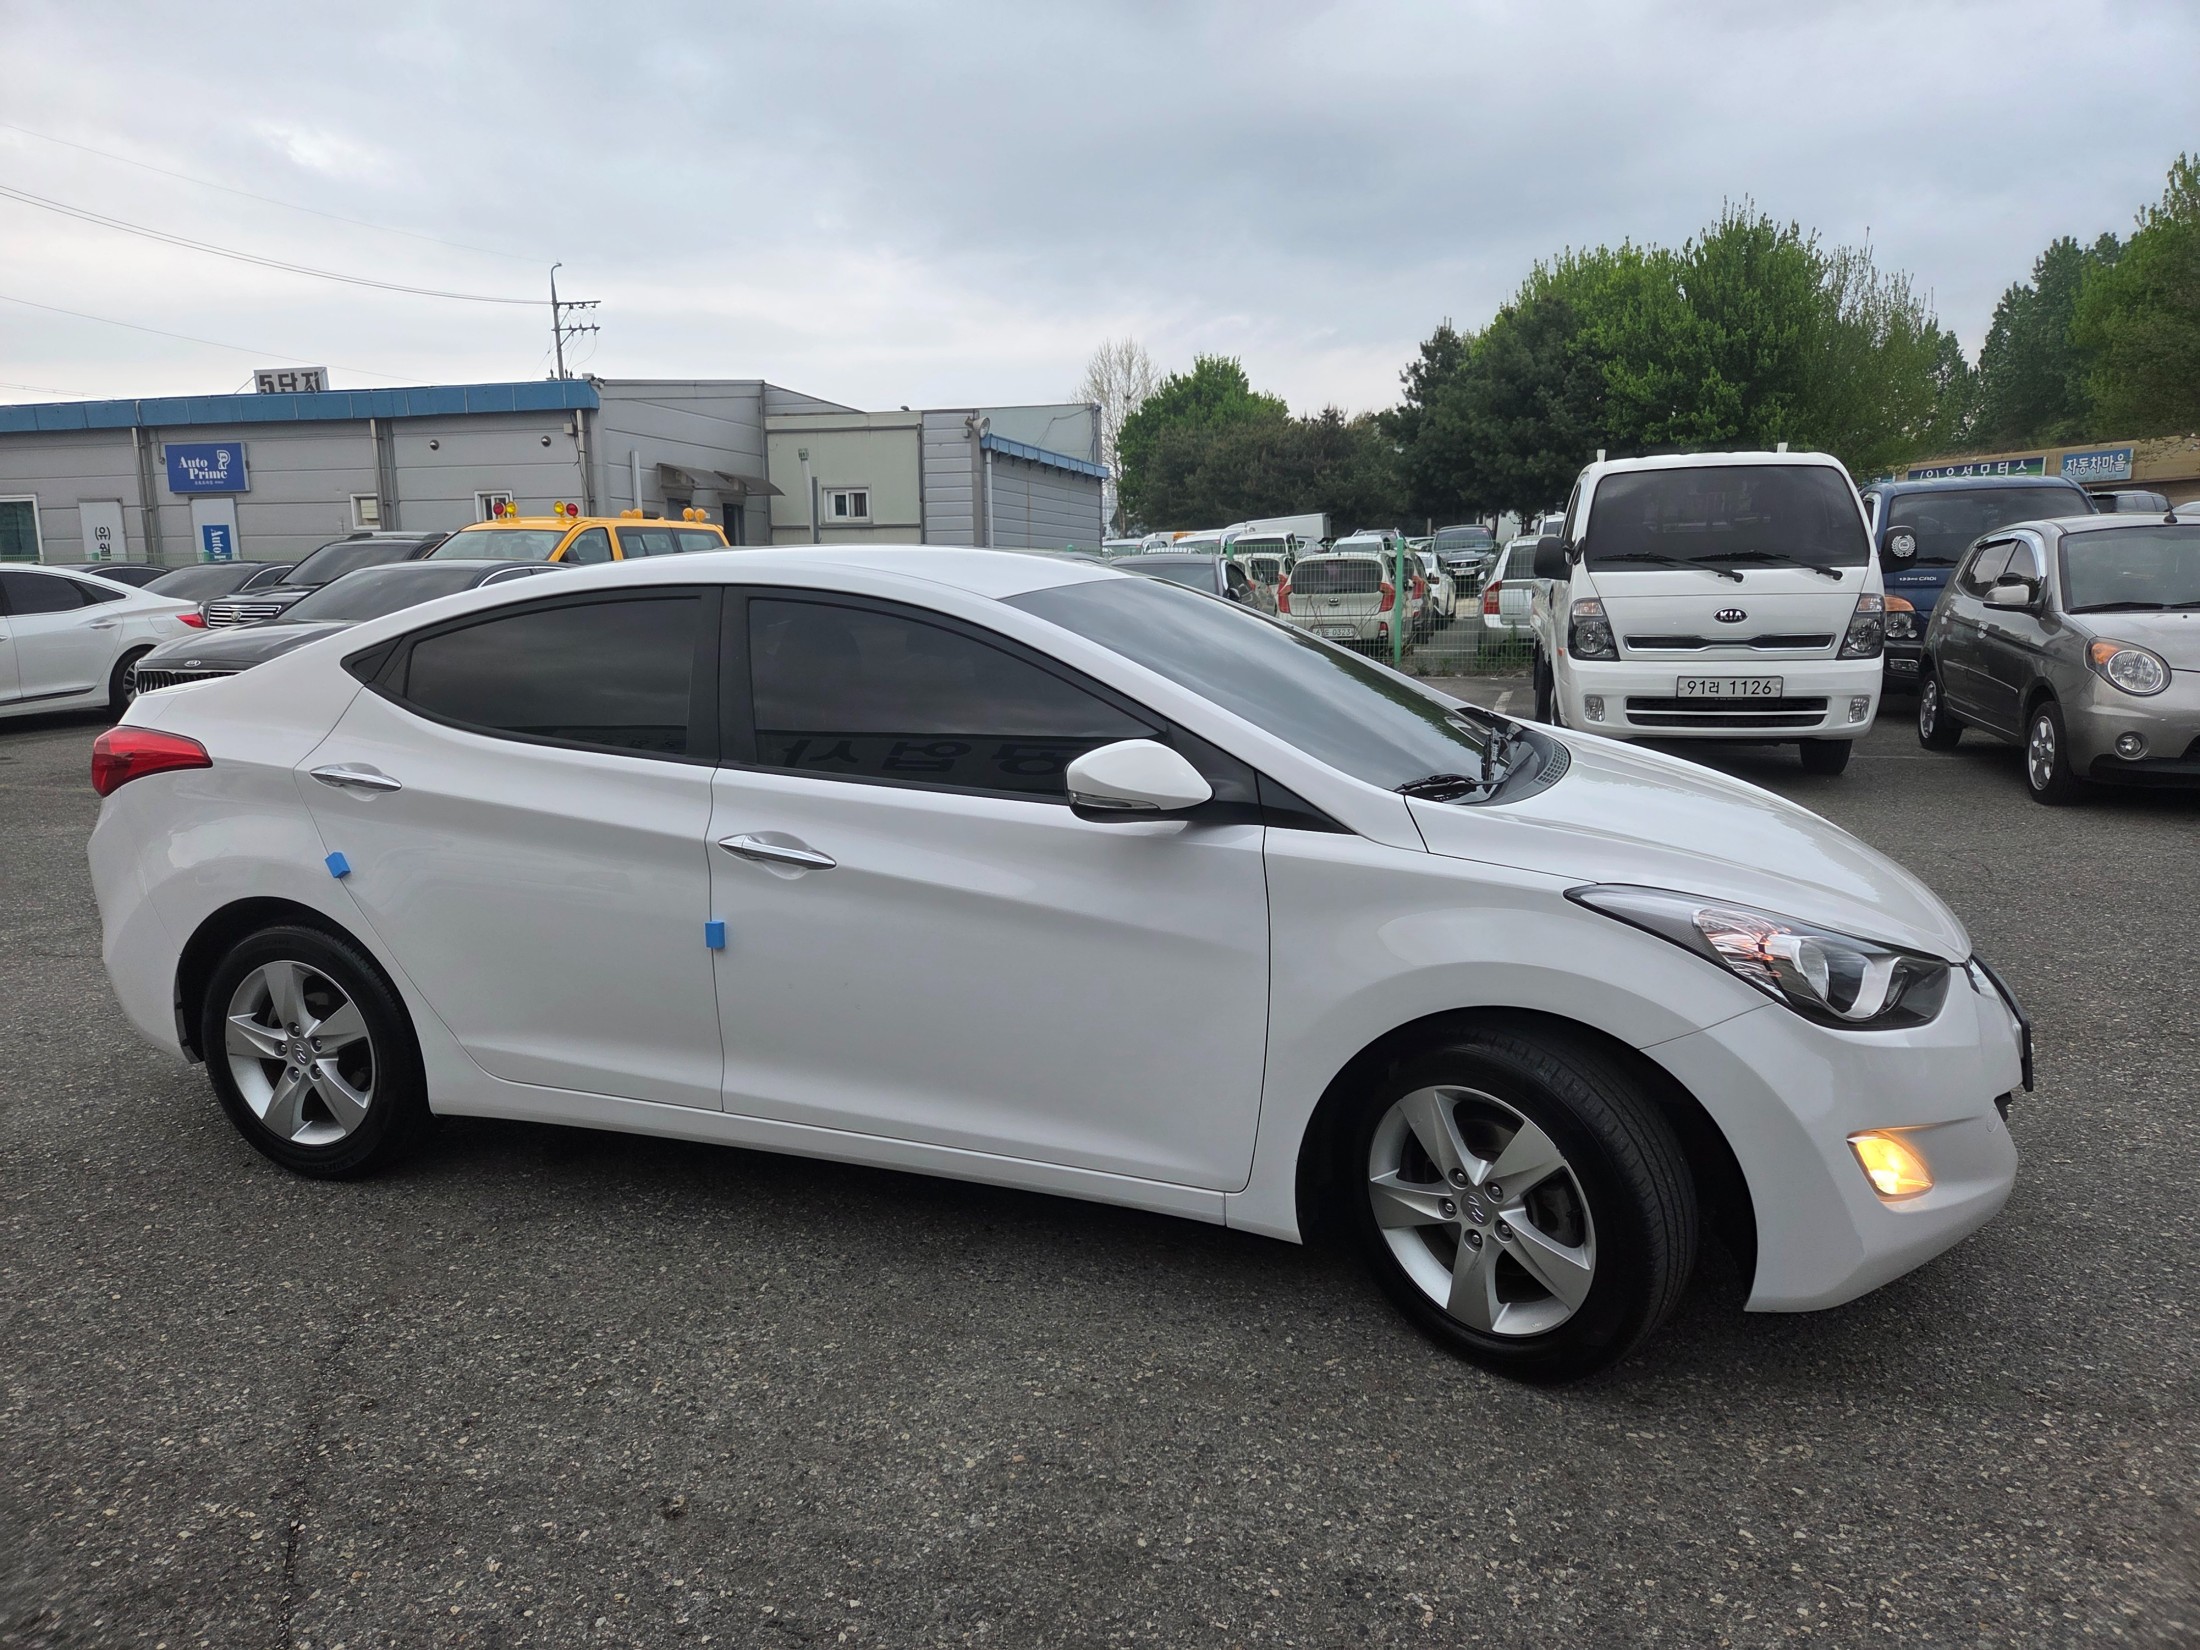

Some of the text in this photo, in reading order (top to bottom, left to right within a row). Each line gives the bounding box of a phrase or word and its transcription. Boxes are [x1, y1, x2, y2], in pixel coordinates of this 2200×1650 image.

[259, 371, 321, 393] 5단지
[179, 456, 208, 468] Auto
[2066, 453, 2126, 475] 자동차마을
[189, 468, 228, 480] Prime
[210, 528, 224, 553] Auto
[1720, 611, 1743, 620] KIA
[1687, 680, 1772, 695] 91러 1126
